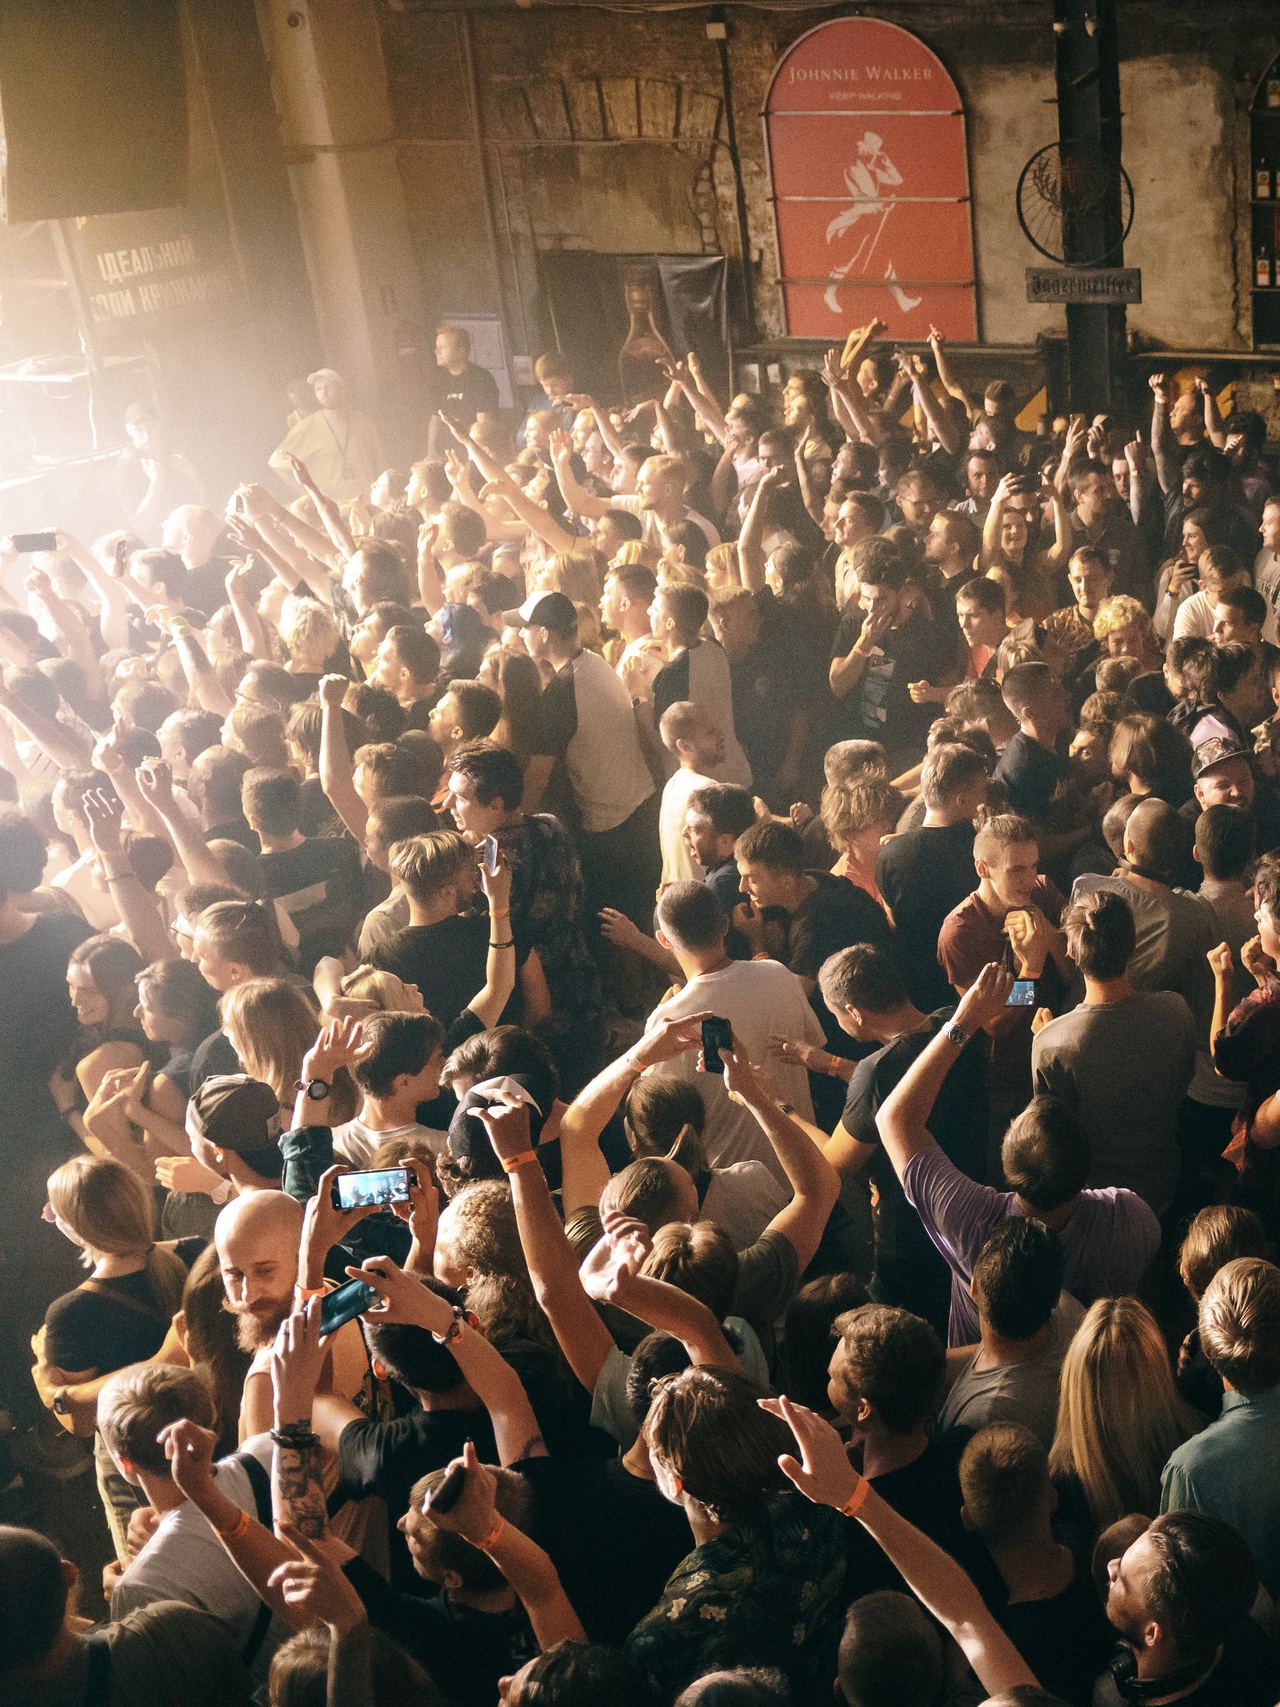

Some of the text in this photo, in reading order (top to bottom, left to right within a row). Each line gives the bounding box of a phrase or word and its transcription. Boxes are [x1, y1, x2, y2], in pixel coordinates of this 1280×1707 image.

[789, 66, 932, 84] JOHNNIE WALKER
[828, 92, 855, 101] KEEP
